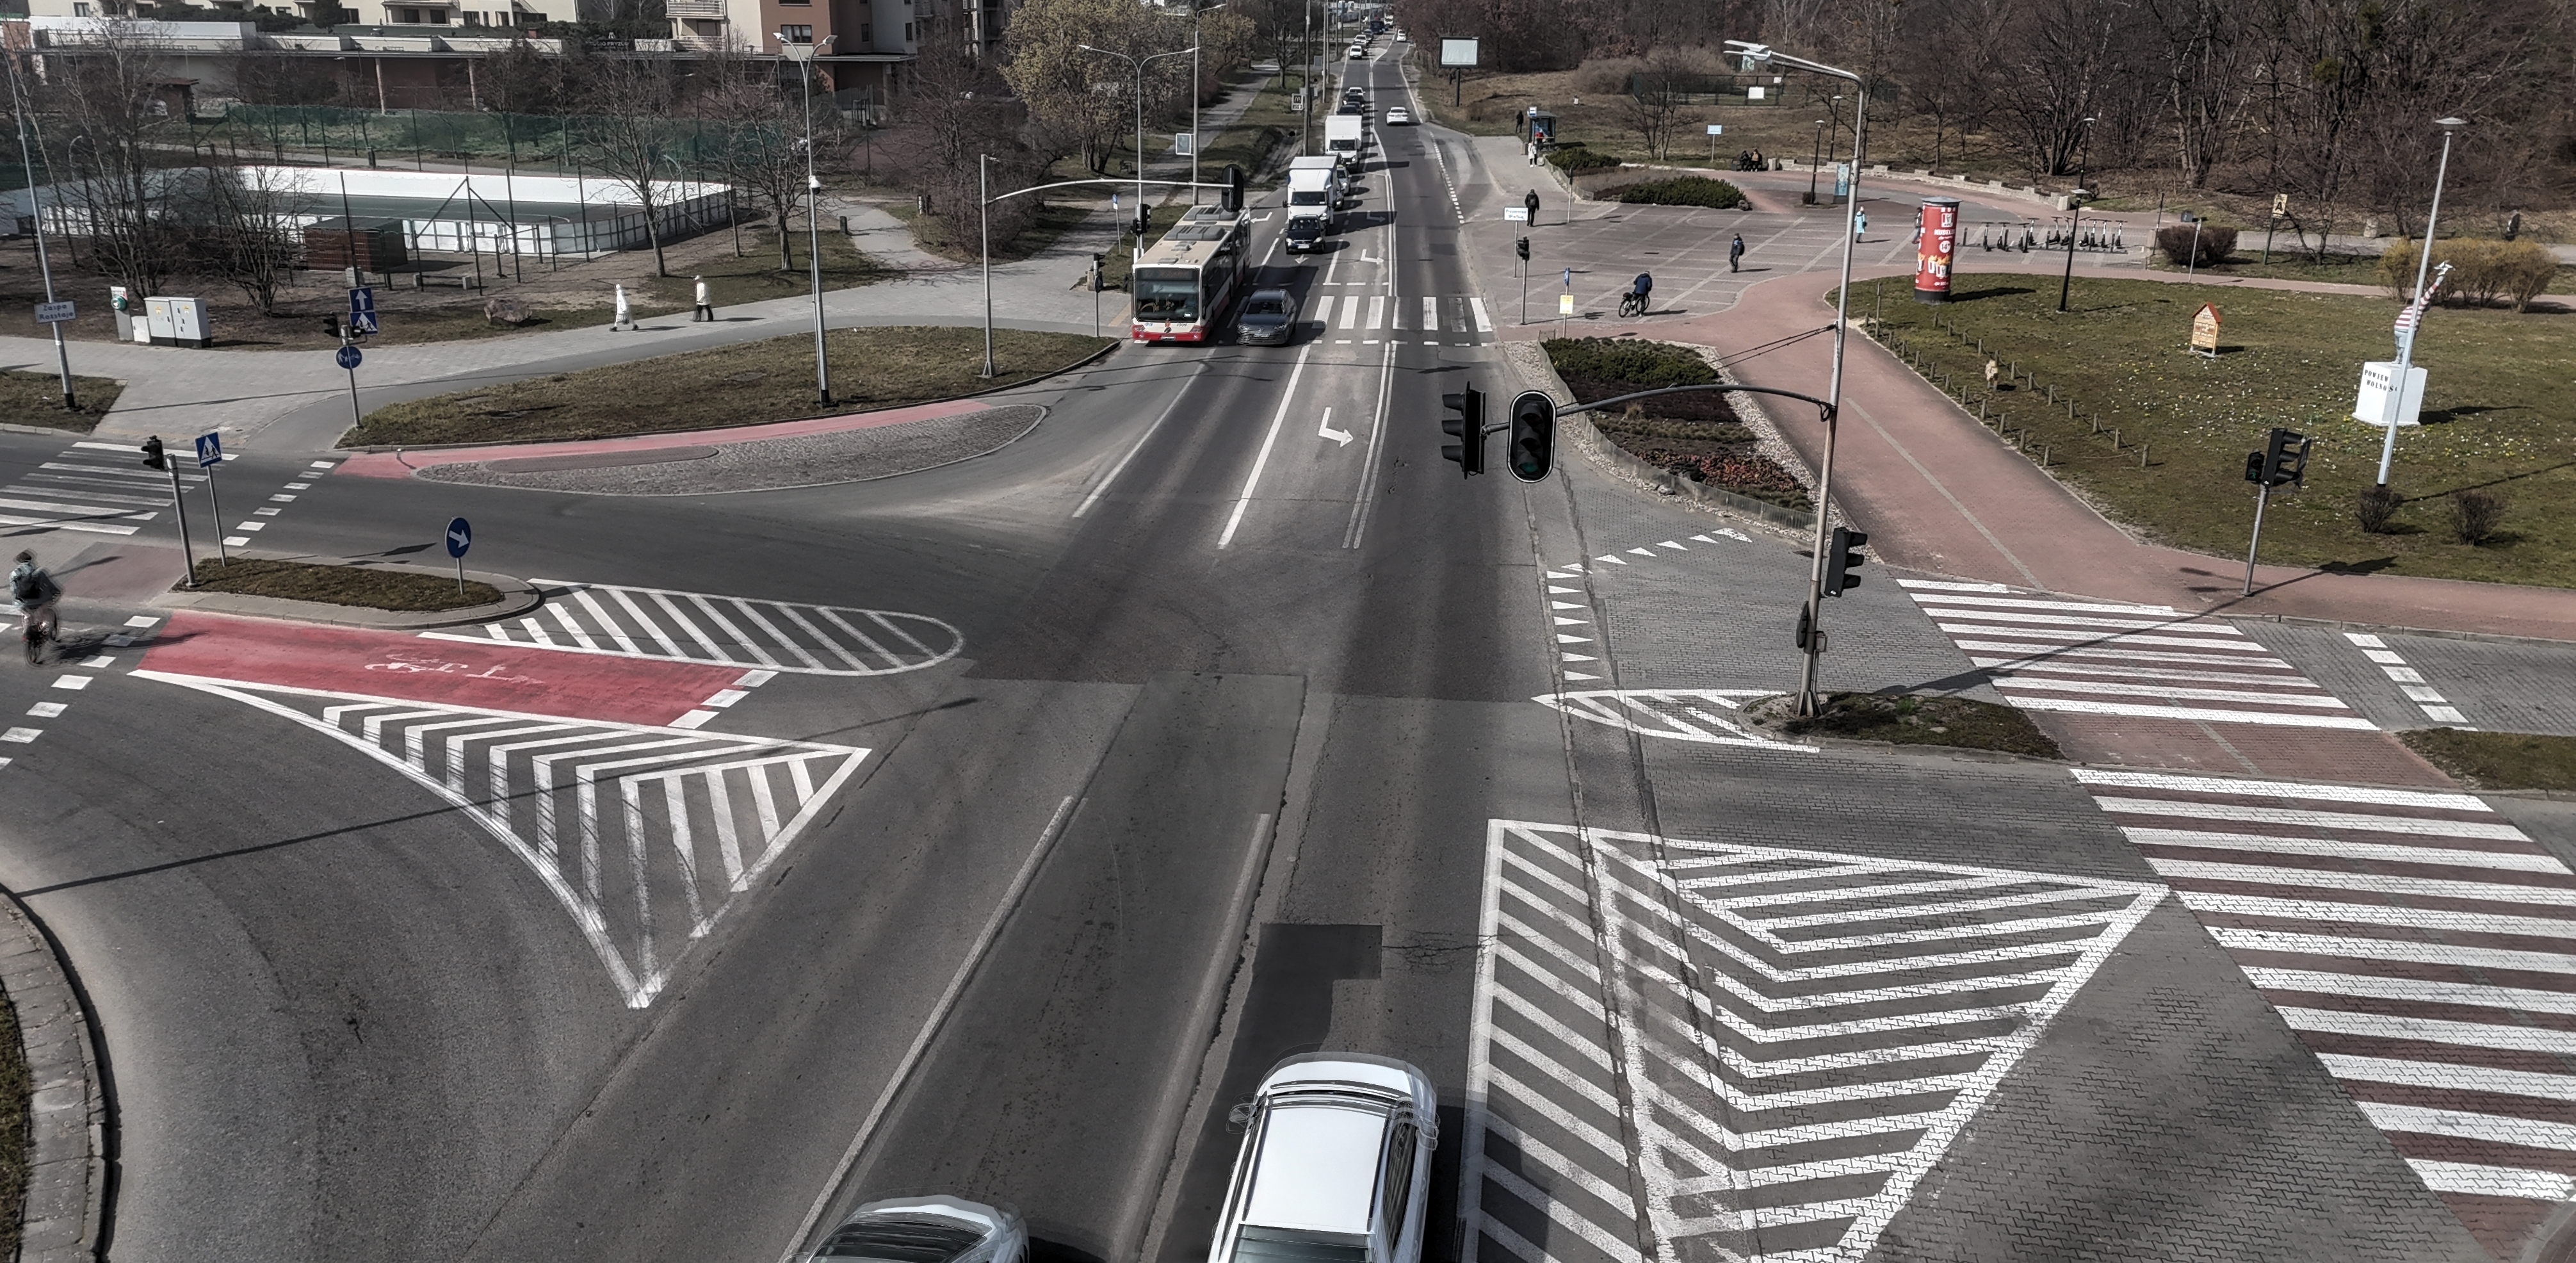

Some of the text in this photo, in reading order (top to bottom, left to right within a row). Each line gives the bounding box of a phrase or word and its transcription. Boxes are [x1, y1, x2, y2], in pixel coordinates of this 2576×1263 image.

[2275, 202, 2283, 211] A
[39, 312, 74, 320] Rozstaje
[2364, 370, 2389, 382] POWIEW
